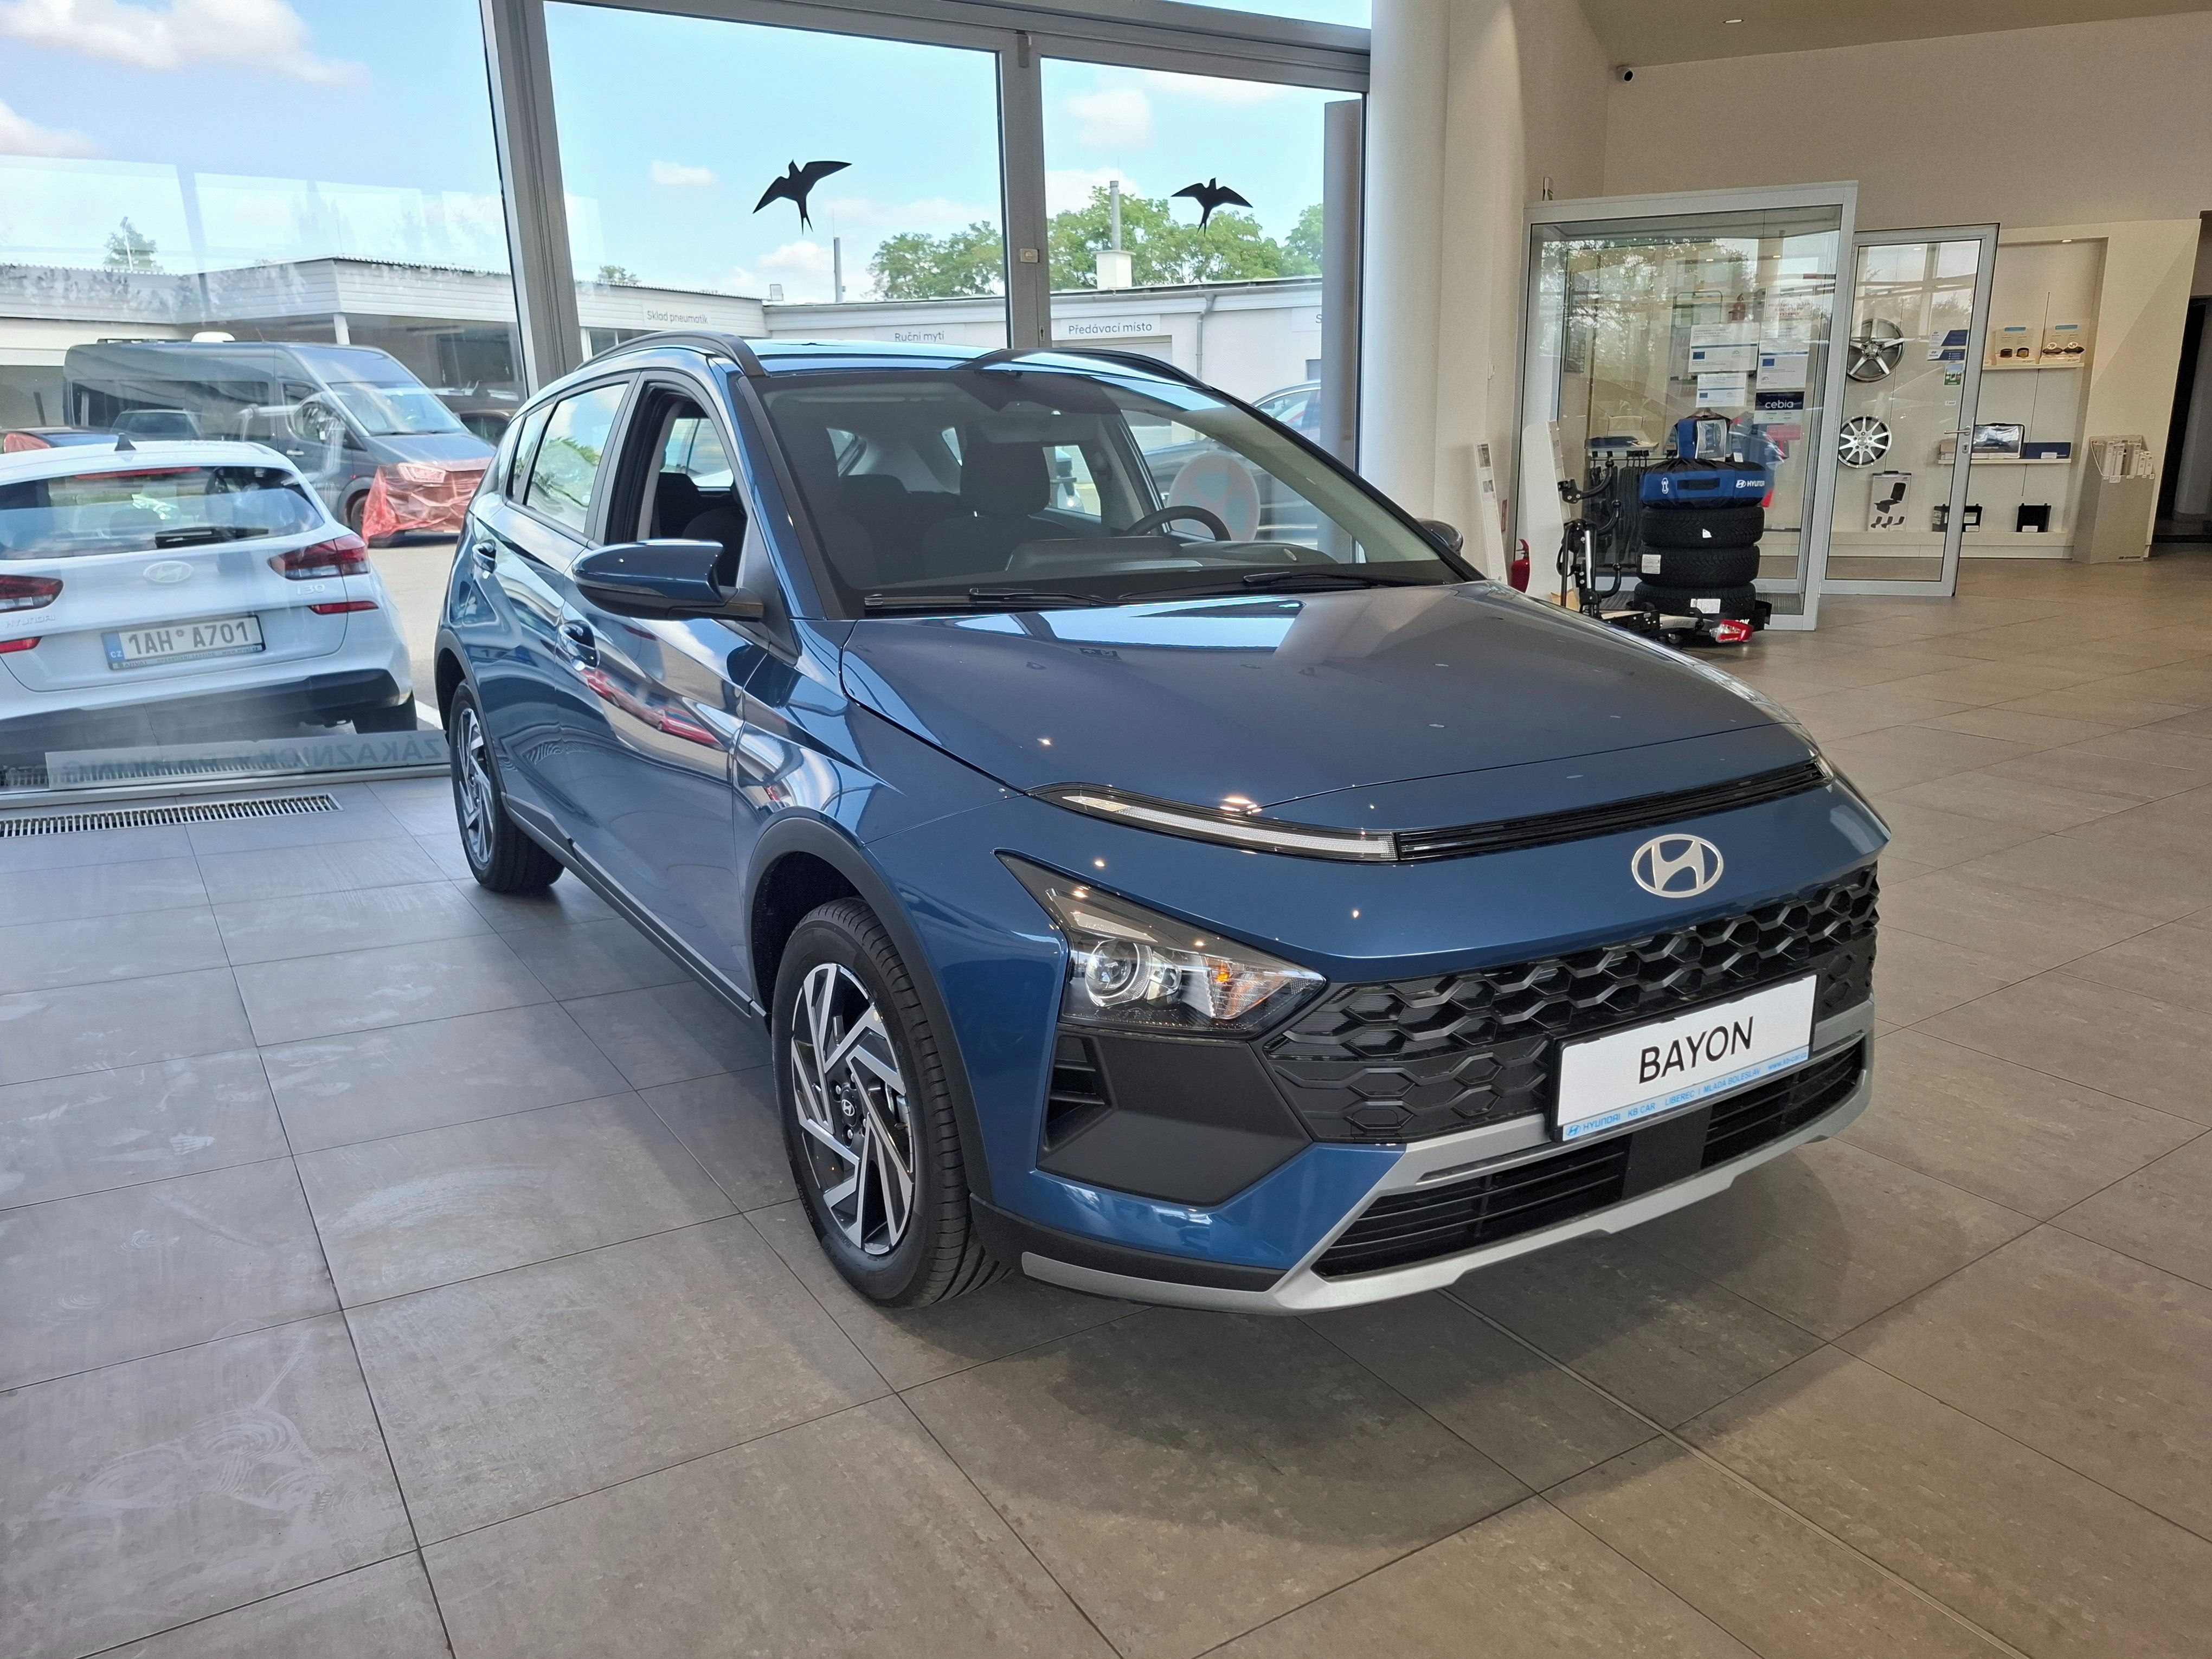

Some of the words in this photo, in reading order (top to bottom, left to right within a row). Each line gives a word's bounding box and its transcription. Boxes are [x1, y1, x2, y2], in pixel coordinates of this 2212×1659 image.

[647, 311, 668, 321] Sklad
[670, 314, 708, 324] pneumatik
[1069, 323, 1121, 335] Předávací
[1123, 321, 1152, 332] místo
[895, 332, 921, 342] Ruční
[1765, 400, 1795, 409] cebia
[6, 614, 56, 629] HYUNDAI
[128, 629, 174, 655] 1AH
[192, 621, 249, 648] A701
[1638, 1015, 1754, 1085] BAYON
[1583, 1113, 1621, 1131] HYUNDAI
[1628, 1109, 1638, 1118] KB
[1640, 1102, 1656, 1114] CAR
[1665, 1090, 1695, 1106] LIBEREC
[1728, 1067, 1761, 1085] BOLESLAV
